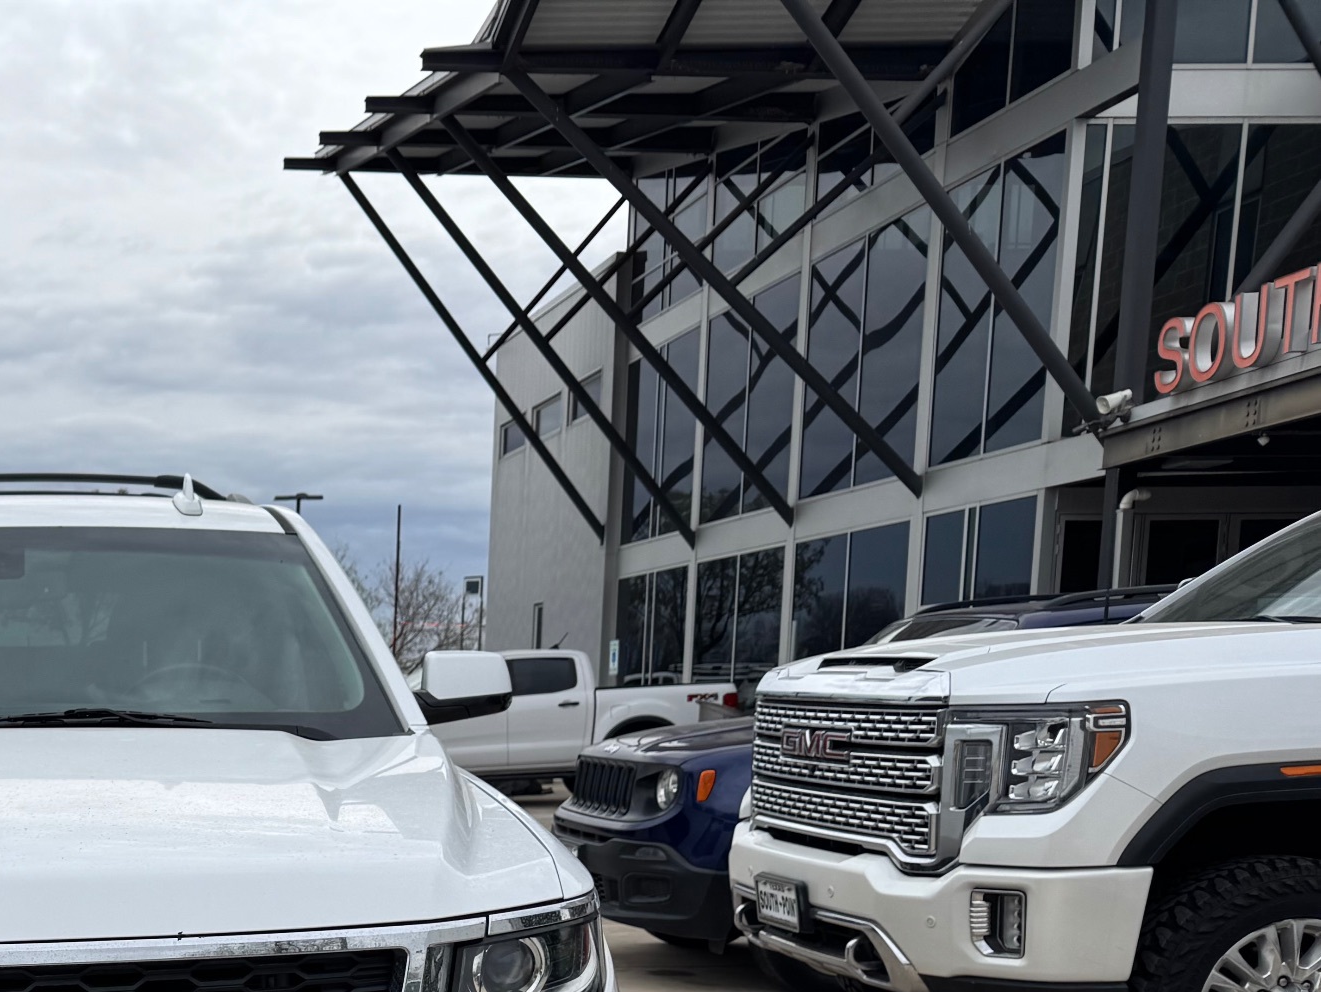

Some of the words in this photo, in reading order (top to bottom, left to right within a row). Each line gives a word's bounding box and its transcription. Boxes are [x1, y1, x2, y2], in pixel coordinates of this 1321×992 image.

[1154, 261, 1321, 394] SOUT
[781, 728, 851, 760] GMC
[759, 890, 780, 913] SOUTH
